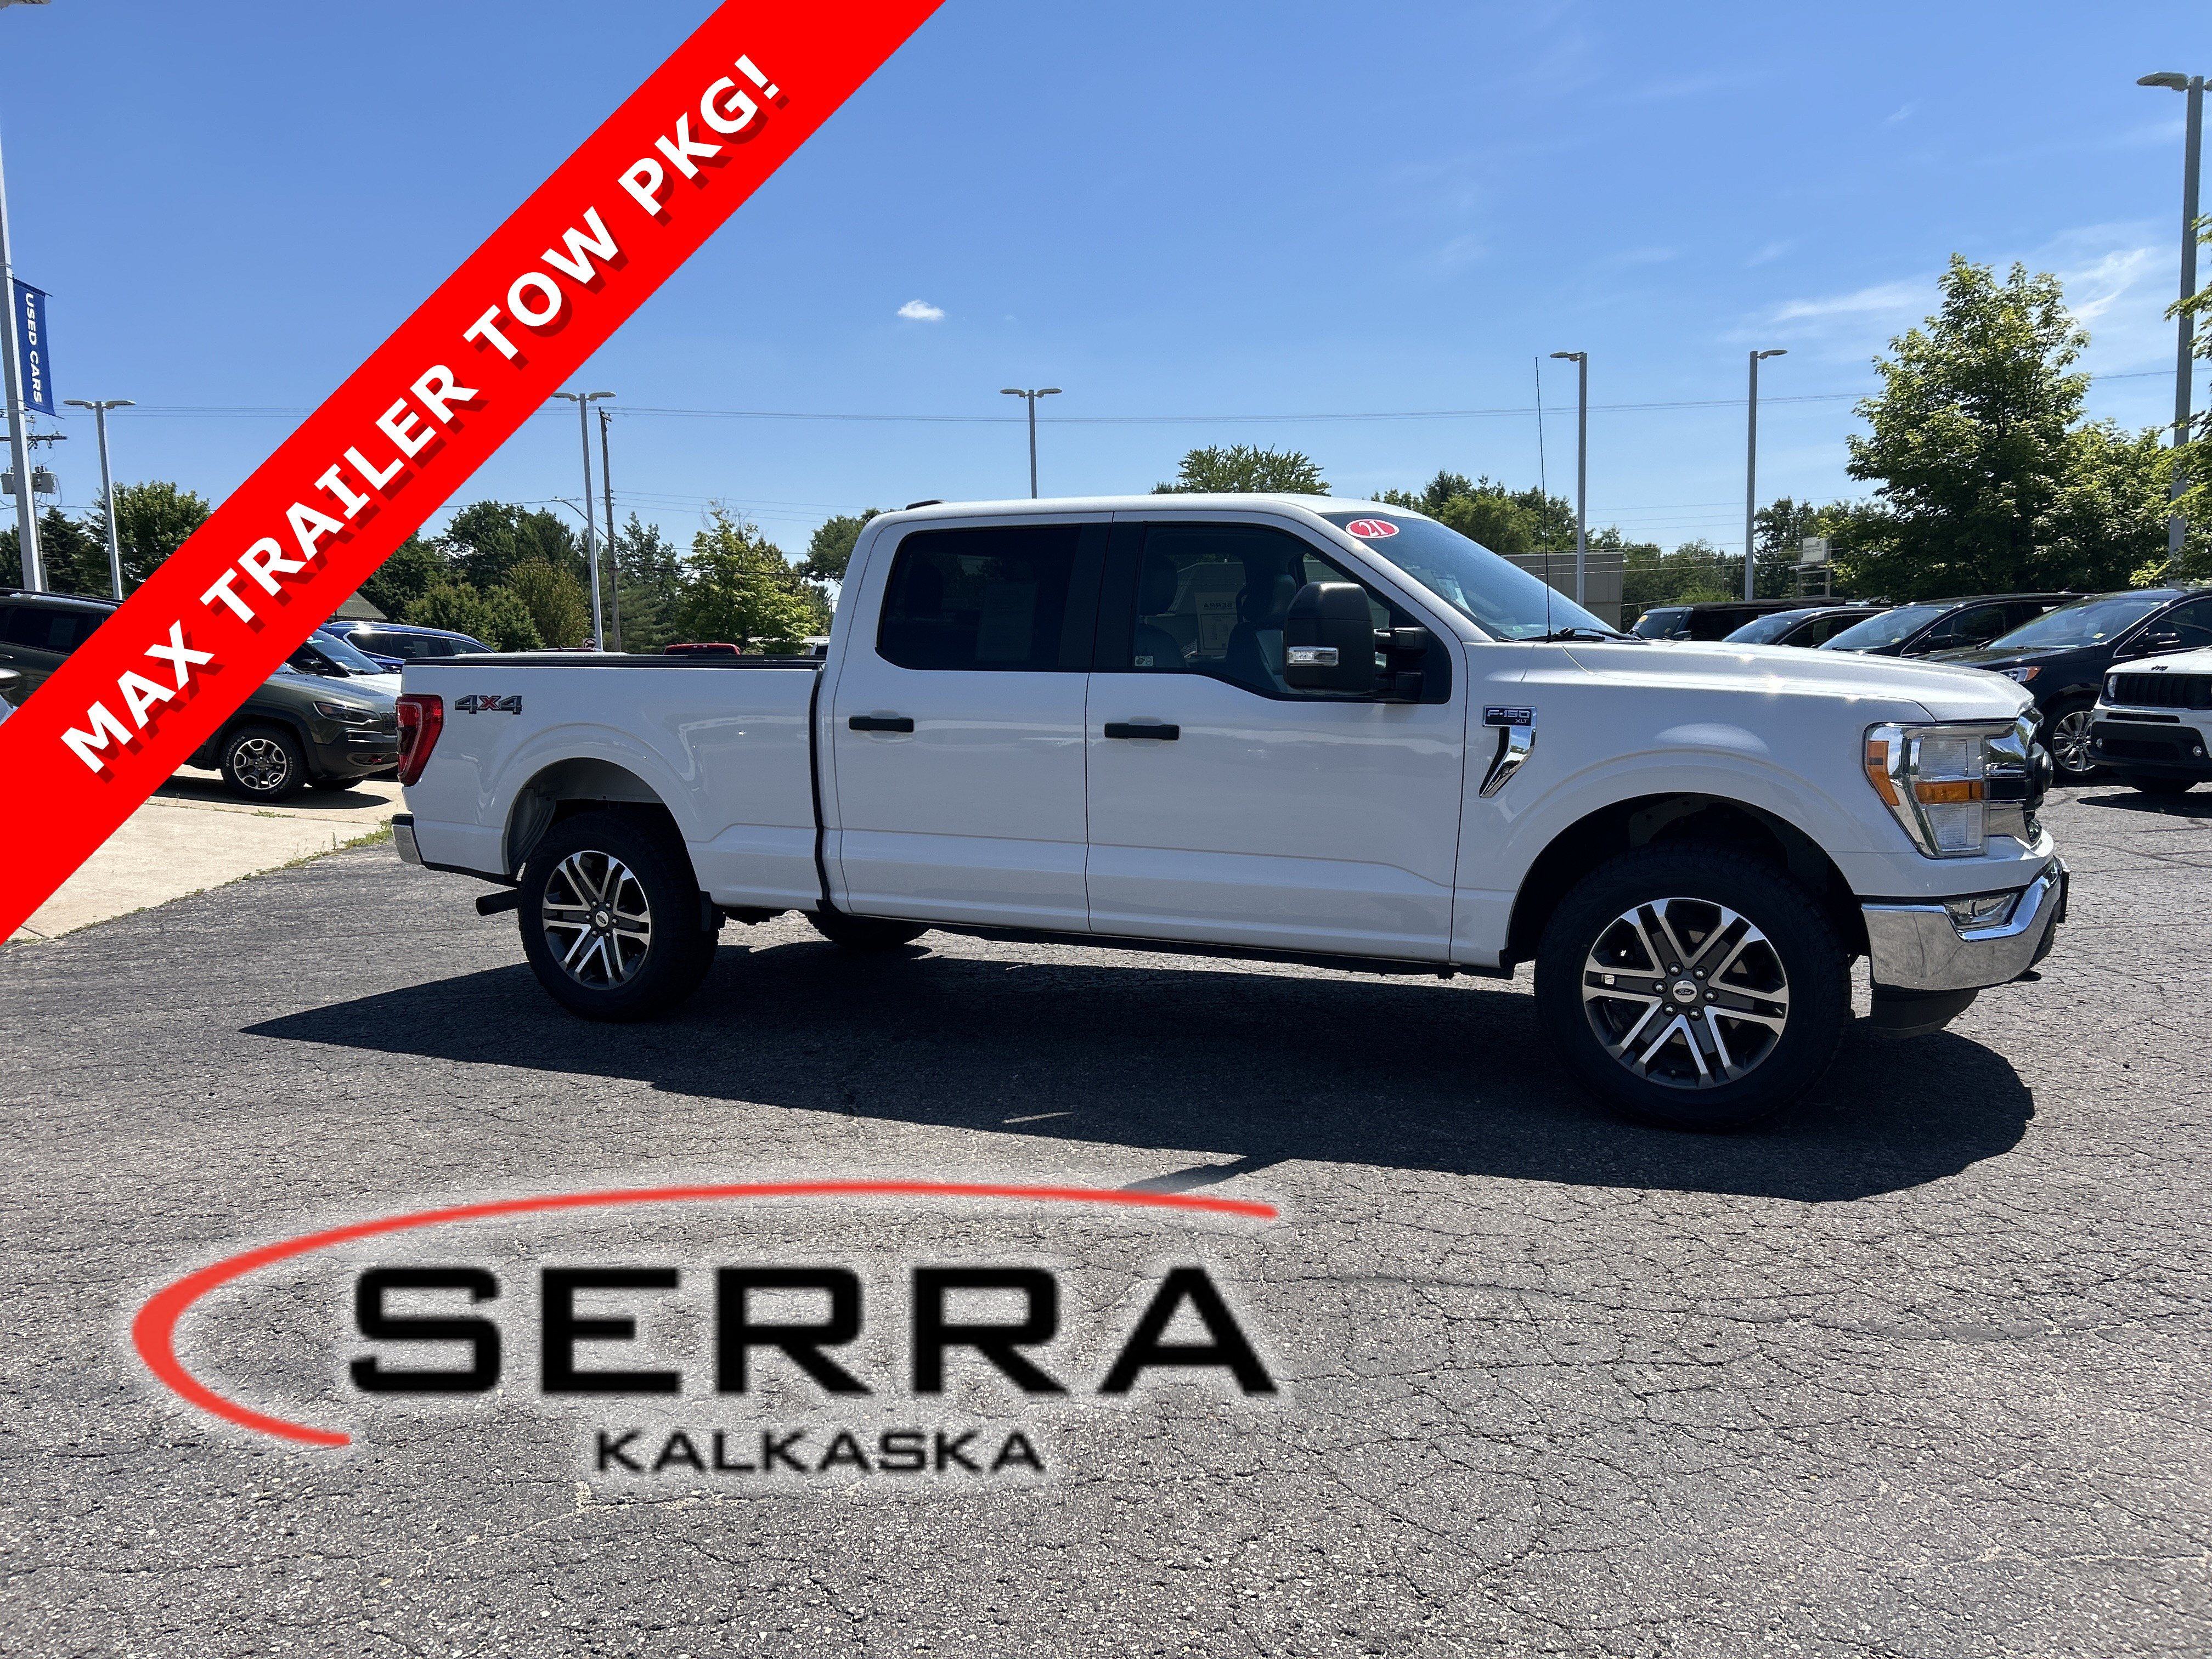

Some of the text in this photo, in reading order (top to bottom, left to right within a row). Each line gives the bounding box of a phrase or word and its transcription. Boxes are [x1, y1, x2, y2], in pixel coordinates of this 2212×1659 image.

[26, 292, 42, 403] USED CARS
[1358, 520, 1389, 537] 21
[1487, 709, 1530, 718] F-150
